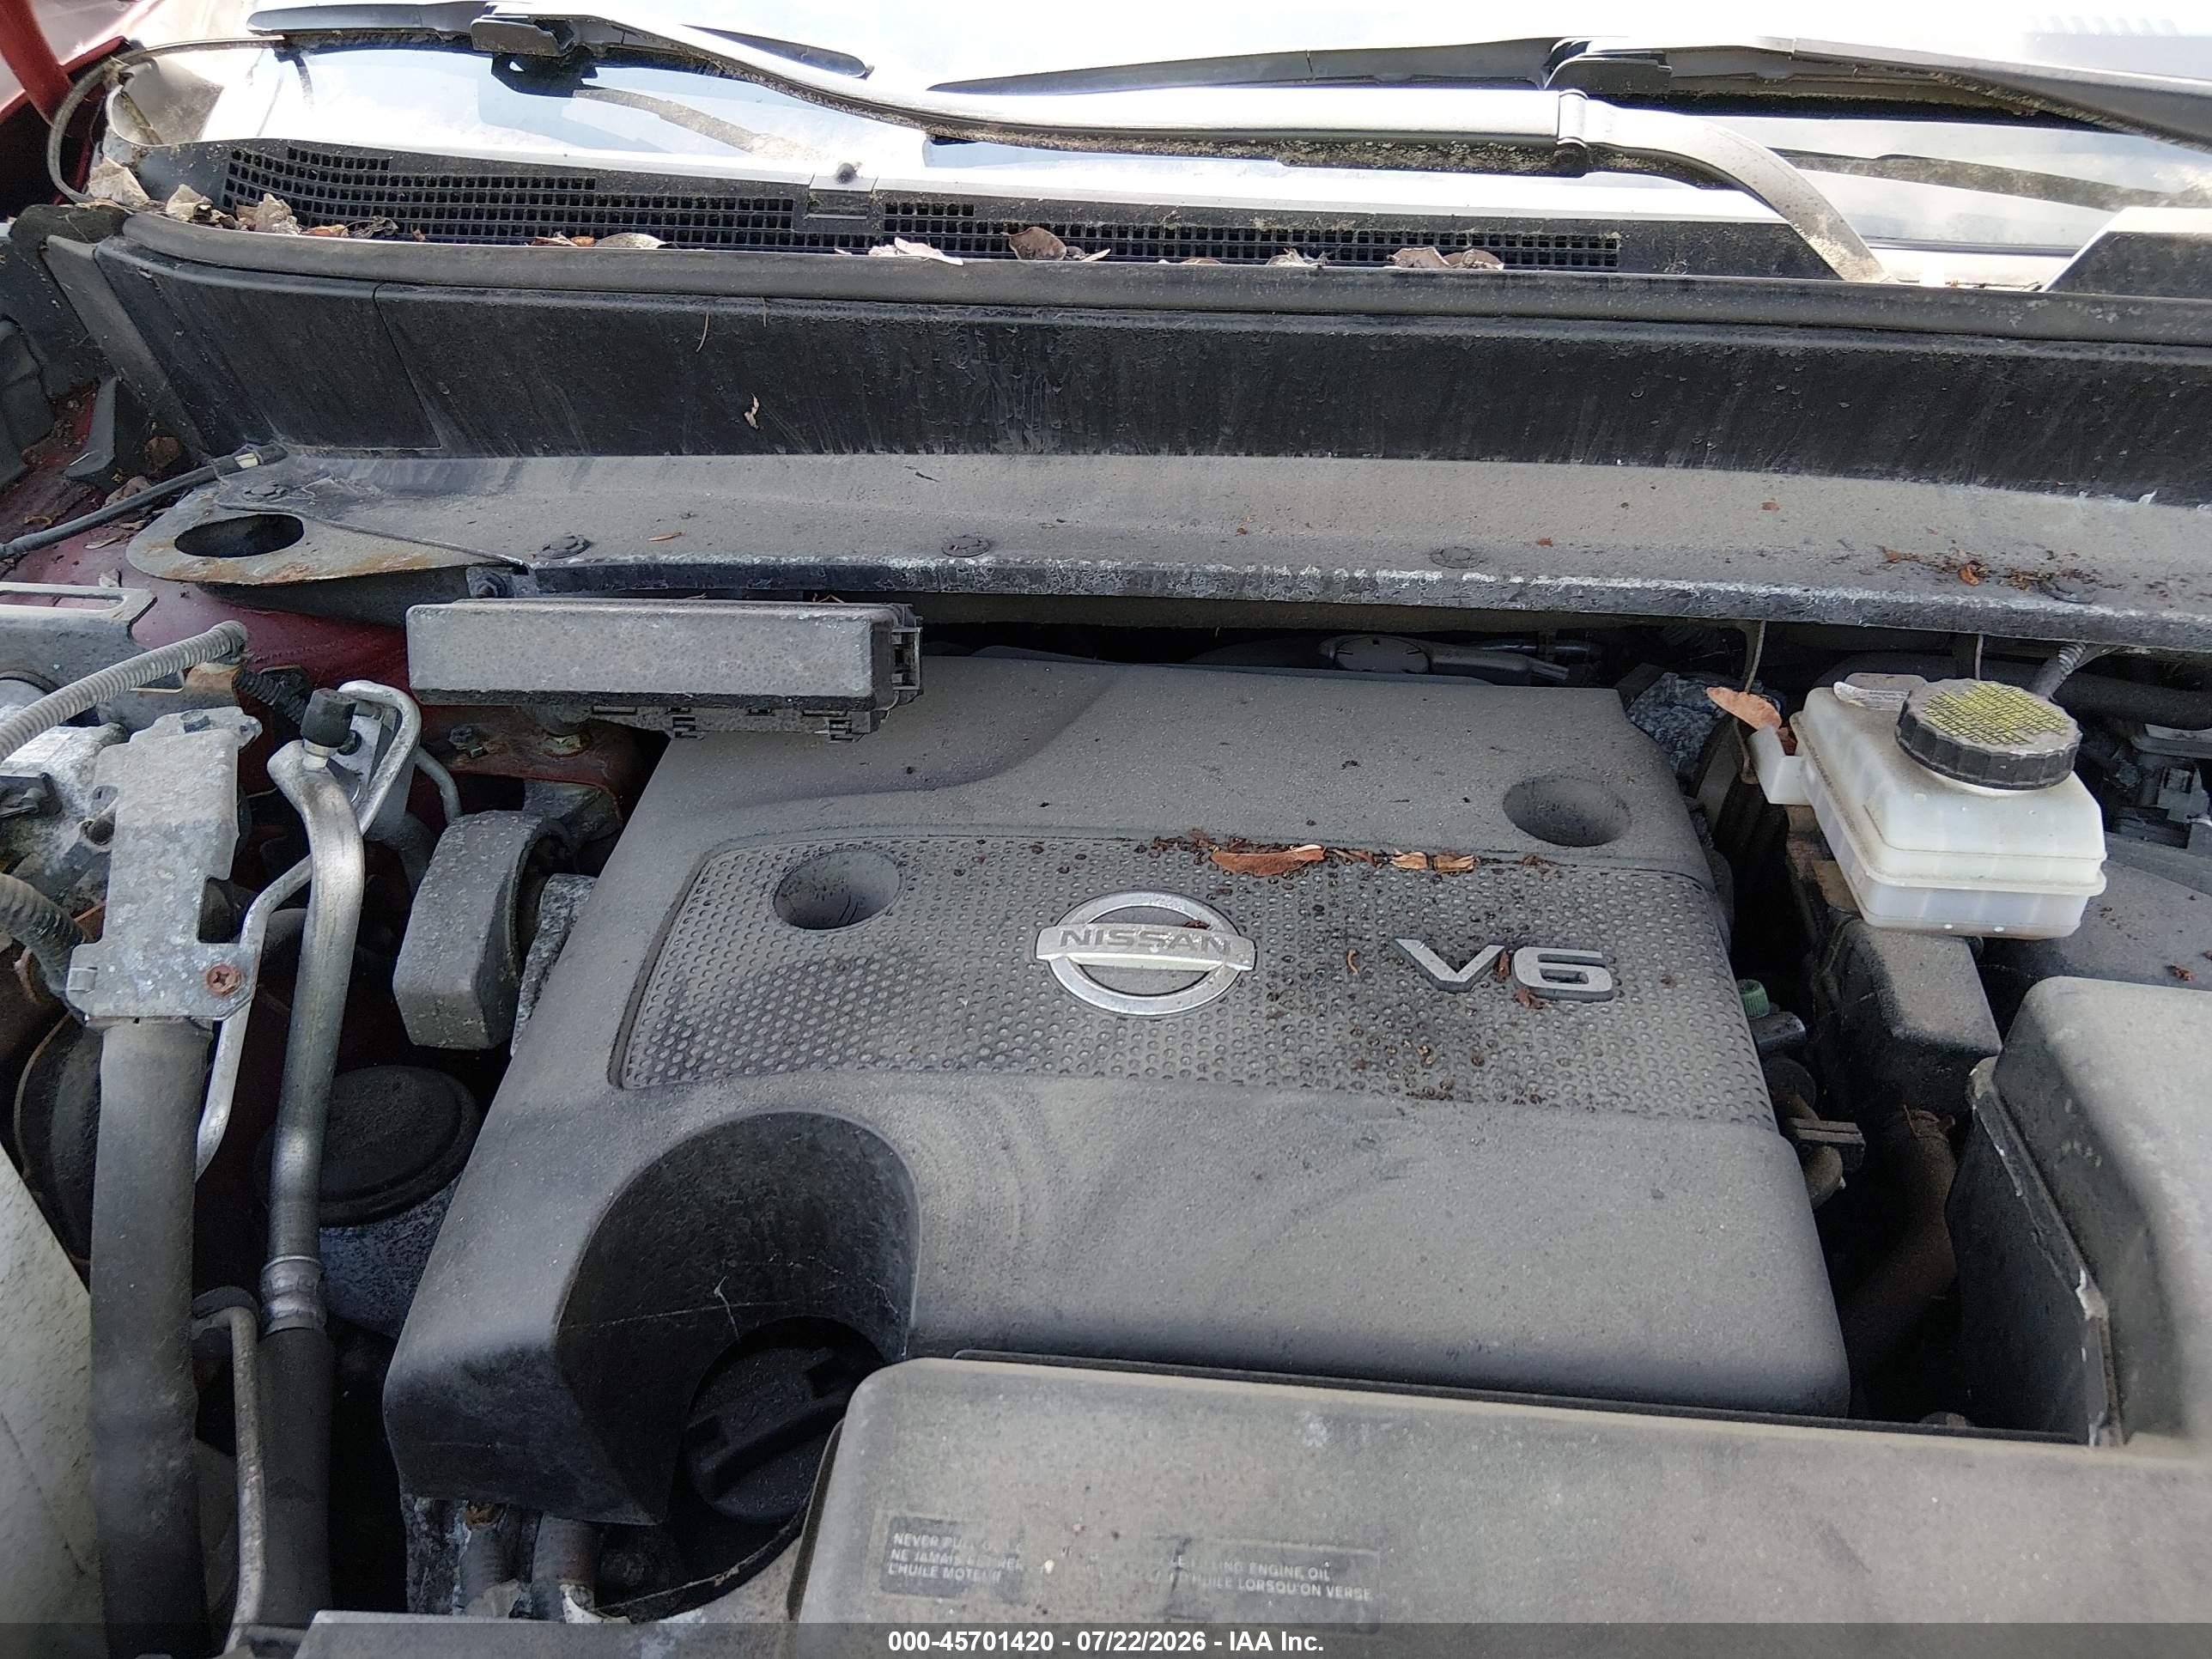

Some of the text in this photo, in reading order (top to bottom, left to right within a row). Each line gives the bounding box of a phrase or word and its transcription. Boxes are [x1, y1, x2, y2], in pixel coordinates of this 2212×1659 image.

[1060, 928, 1231, 958] NISSAN
[1396, 937, 1614, 1001] V6
[893, 1533, 939, 1547] NEVER
[890, 1548, 908, 1562] NE
[1249, 1562, 1304, 1581] ENGINE
[1307, 1566, 1330, 1582] OIL
[1326, 1584, 1373, 1601] VERSE
